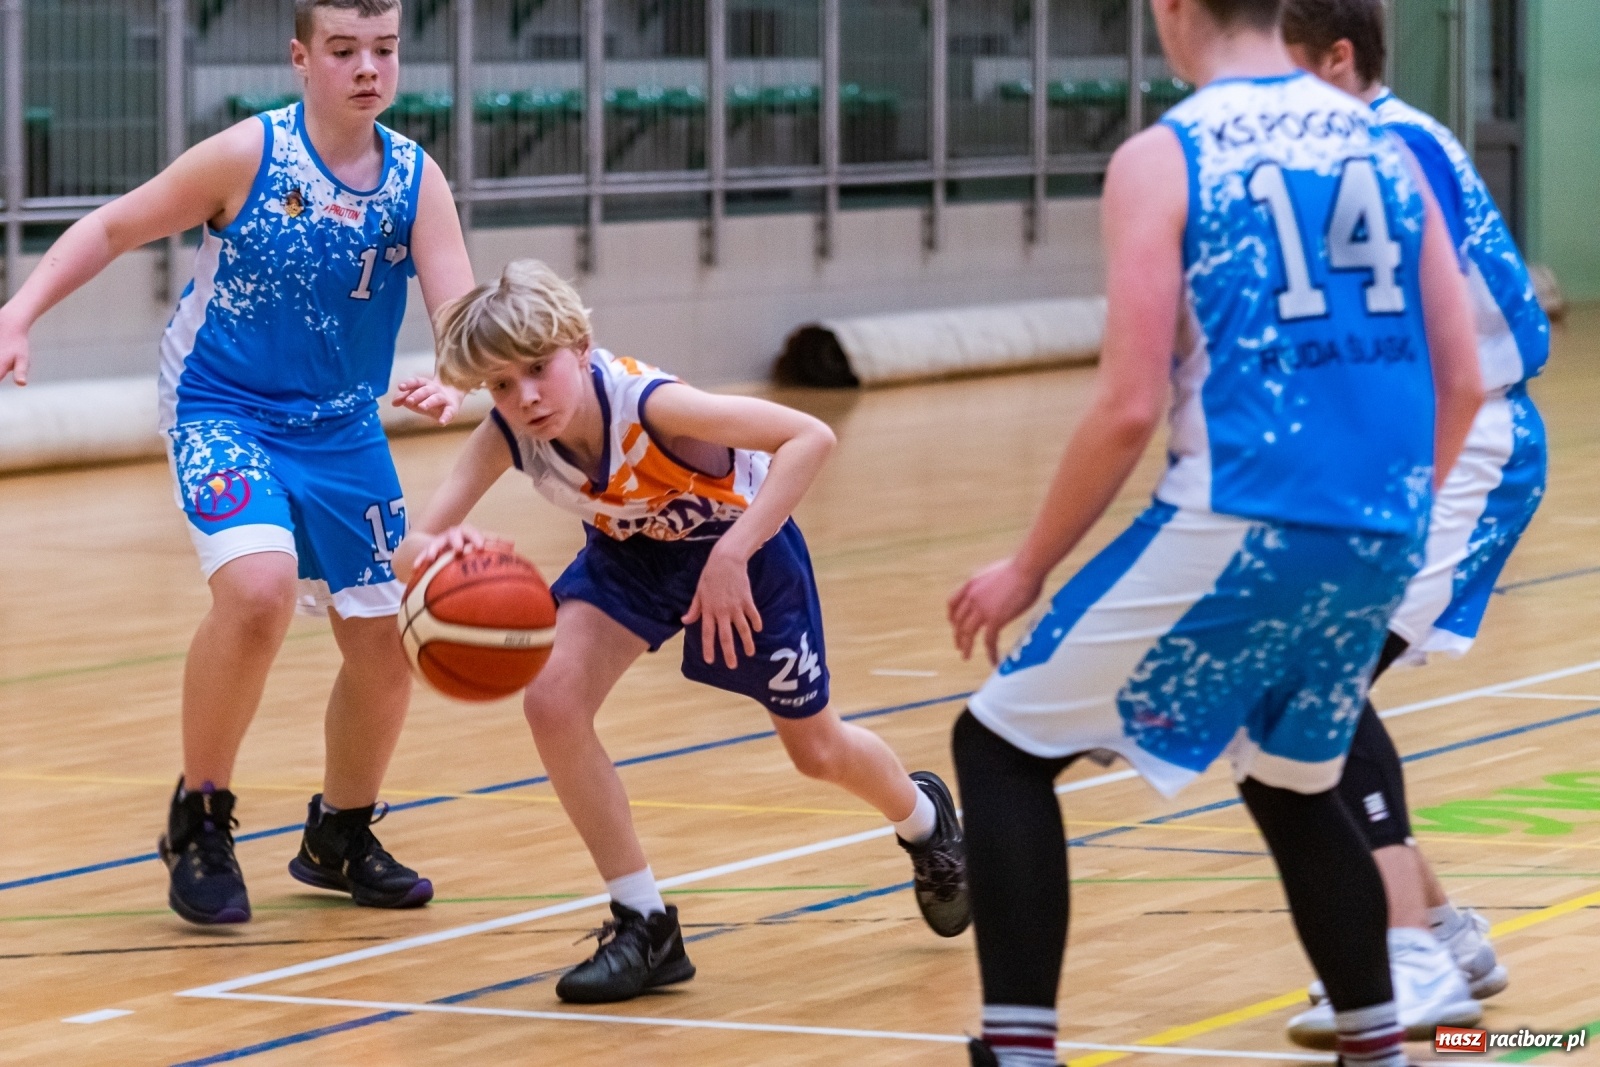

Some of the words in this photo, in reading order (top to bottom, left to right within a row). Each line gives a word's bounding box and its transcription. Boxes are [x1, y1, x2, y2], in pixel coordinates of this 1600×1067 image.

[1210, 113, 1255, 147] KS
[328, 203, 361, 220] PROTON
[1247, 157, 1406, 323] 14
[768, 631, 821, 692] 24
